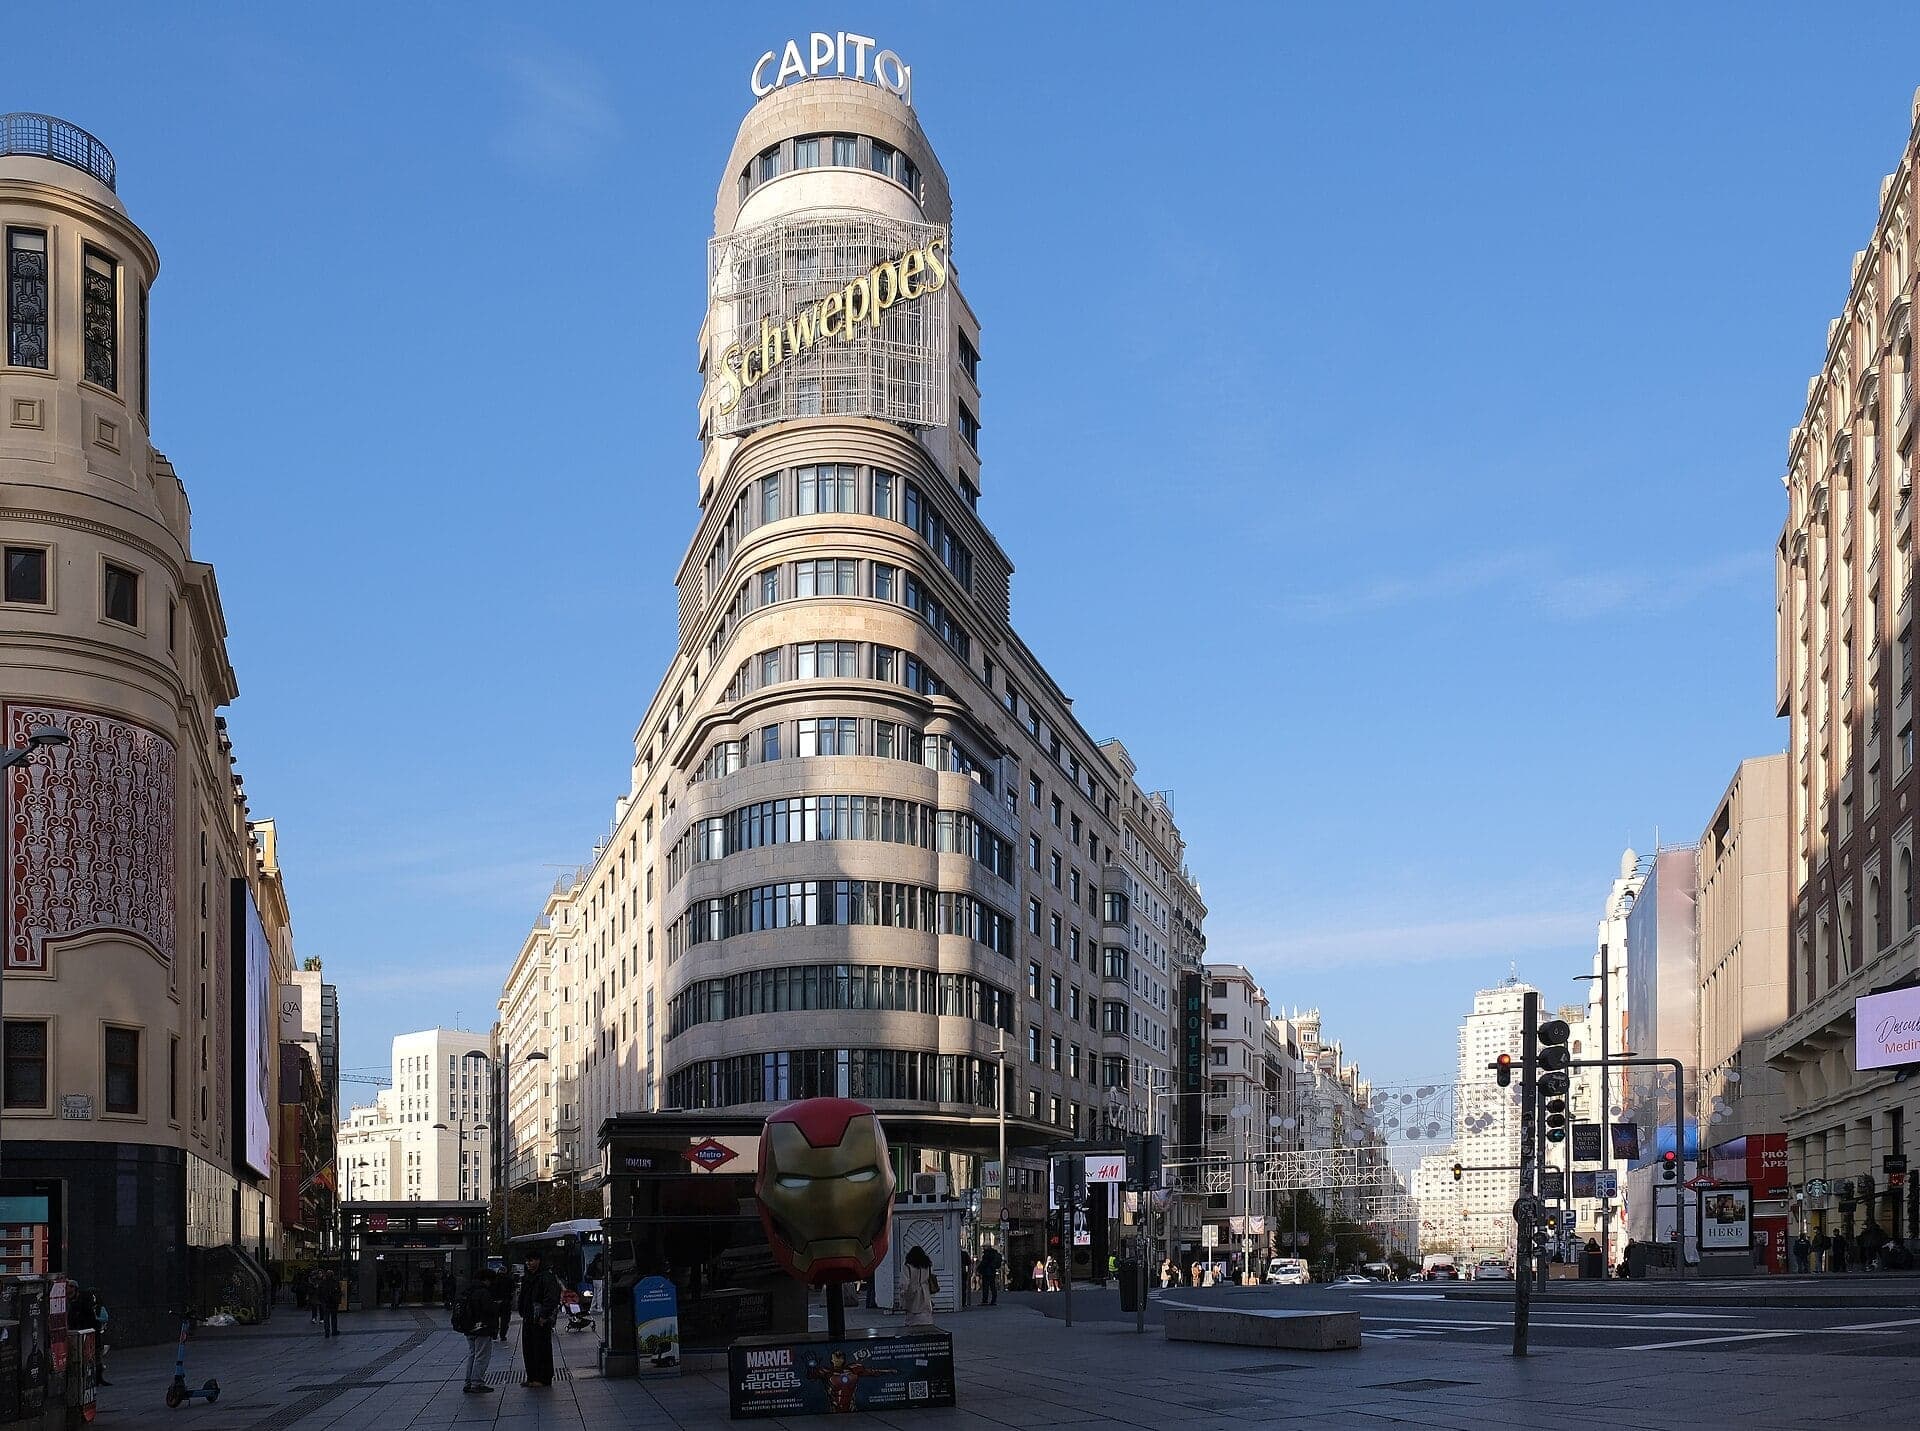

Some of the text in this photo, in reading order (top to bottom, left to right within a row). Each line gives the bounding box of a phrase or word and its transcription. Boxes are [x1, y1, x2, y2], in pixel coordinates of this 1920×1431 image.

[719, 238, 947, 416] Schweppes
[1188, 997, 1199, 1088] HOTEL
[699, 1149, 723, 1158] Metro
[1708, 1227, 1744, 1237] HERE
[746, 1349, 793, 1368] MARVEL
[745, 1371, 795, 1383] SUPER
[741, 1379, 802, 1391] HEROES
